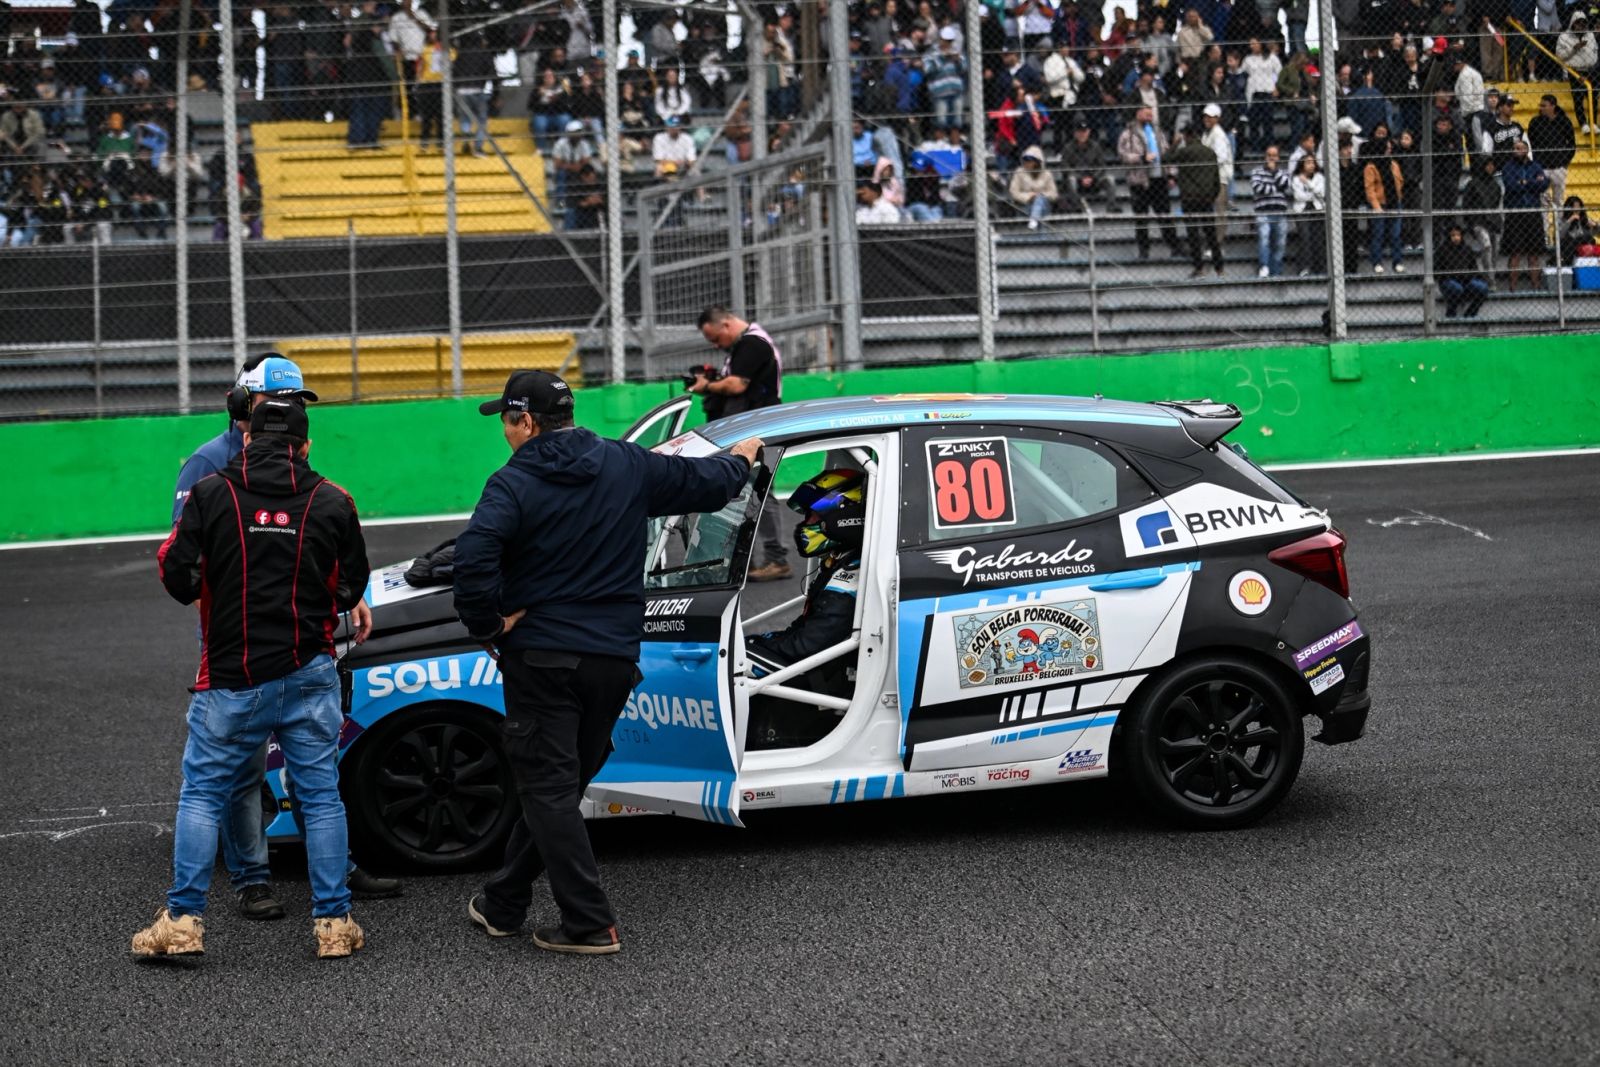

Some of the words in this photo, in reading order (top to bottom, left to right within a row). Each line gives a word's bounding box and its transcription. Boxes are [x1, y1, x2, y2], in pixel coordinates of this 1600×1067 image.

[1224, 364, 1300, 416] 35
[840, 414, 890, 427] CUCINOTTA
[937, 442, 992, 457] ZUNKY
[970, 450, 995, 458] RODAS
[934, 458, 1006, 523] 80
[837, 517, 865, 528] sparc
[1185, 504, 1285, 534] BRWM
[249, 526, 296, 535] @eucommracing
[924, 539, 1094, 587] Gabardo
[975, 570, 1034, 583] TRANSPORTE
[1036, 568, 1048, 577] DE
[1050, 564, 1096, 576] VEICULOS
[645, 598, 694, 616] UNDAI
[643, 620, 686, 633] NCIAMENTOS
[972, 631, 992, 655] SOU
[990, 613, 1021, 638] BELGA
[1024, 607, 1090, 637] PORRRRAAA!
[1296, 626, 1352, 662] SPEEDMAX
[994, 673, 1034, 686] BRUXELLES
[1039, 667, 1074, 680] BELGIQUE
[1311, 666, 1340, 686] TECPADS
[619, 689, 719, 731] SQUARE
[618, 728, 651, 744] LTDA
[941, 776, 976, 789] MOBIS
[988, 768, 1030, 781] racing
